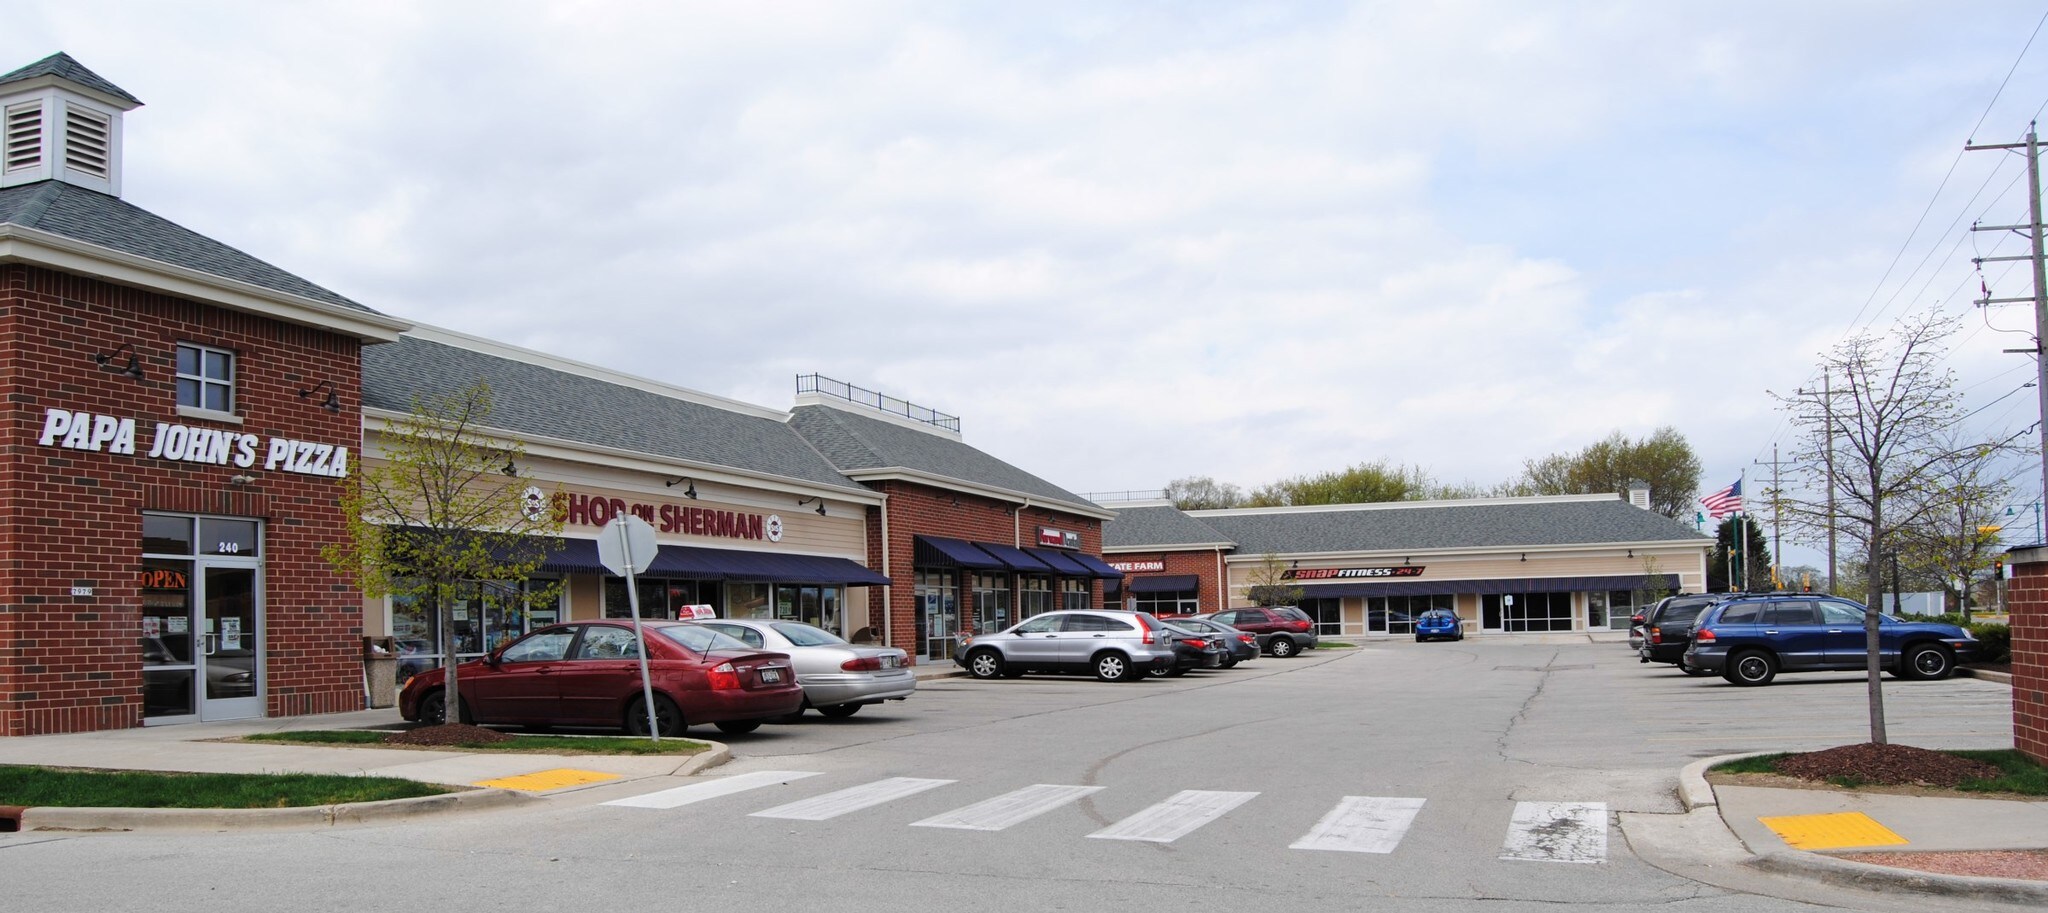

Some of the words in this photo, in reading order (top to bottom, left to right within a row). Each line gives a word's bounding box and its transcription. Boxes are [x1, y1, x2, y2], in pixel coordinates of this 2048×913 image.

[39, 408, 136, 455] PAPA
[148, 422, 259, 468] JOHN'S
[264, 438, 348, 478] PIZZA
[551, 491, 627, 527] SHOP
[660, 504, 763, 540] SHERMAN
[219, 542, 239, 553] 240
[1134, 562, 1164, 570] FARM
[1337, 568, 1392, 577] FITNESS
[141, 570, 185, 588] OPEN
